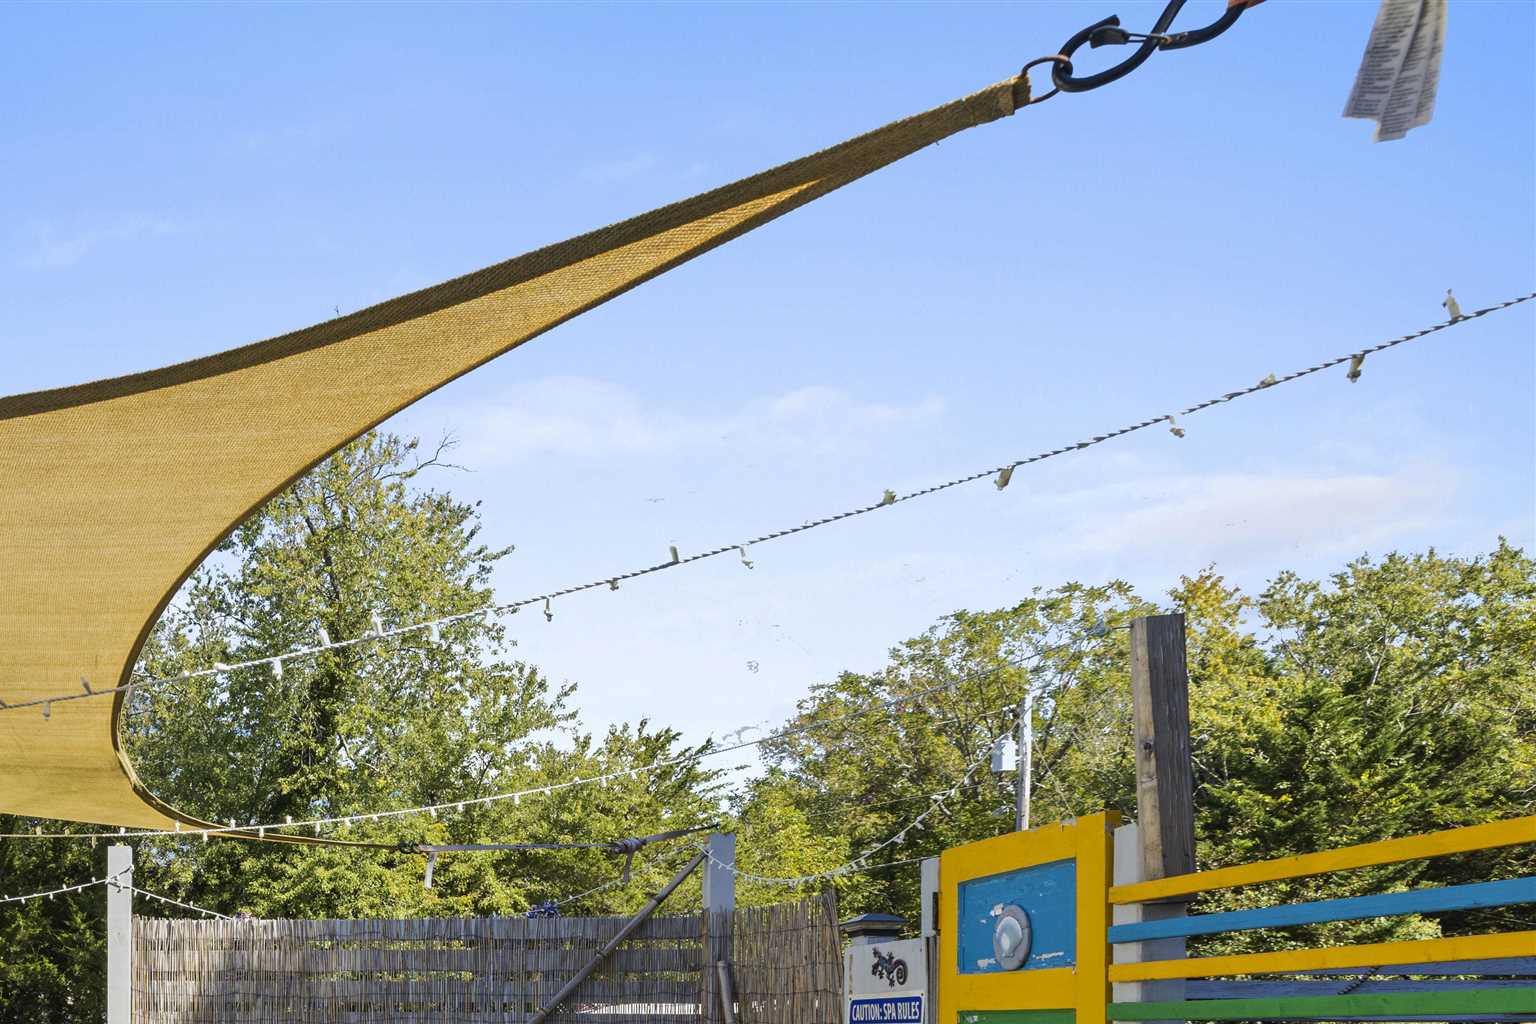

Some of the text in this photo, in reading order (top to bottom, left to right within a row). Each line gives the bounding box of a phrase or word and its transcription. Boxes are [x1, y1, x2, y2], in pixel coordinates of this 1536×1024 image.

[852, 1001, 920, 1021] CAUTION: SPA RULES
